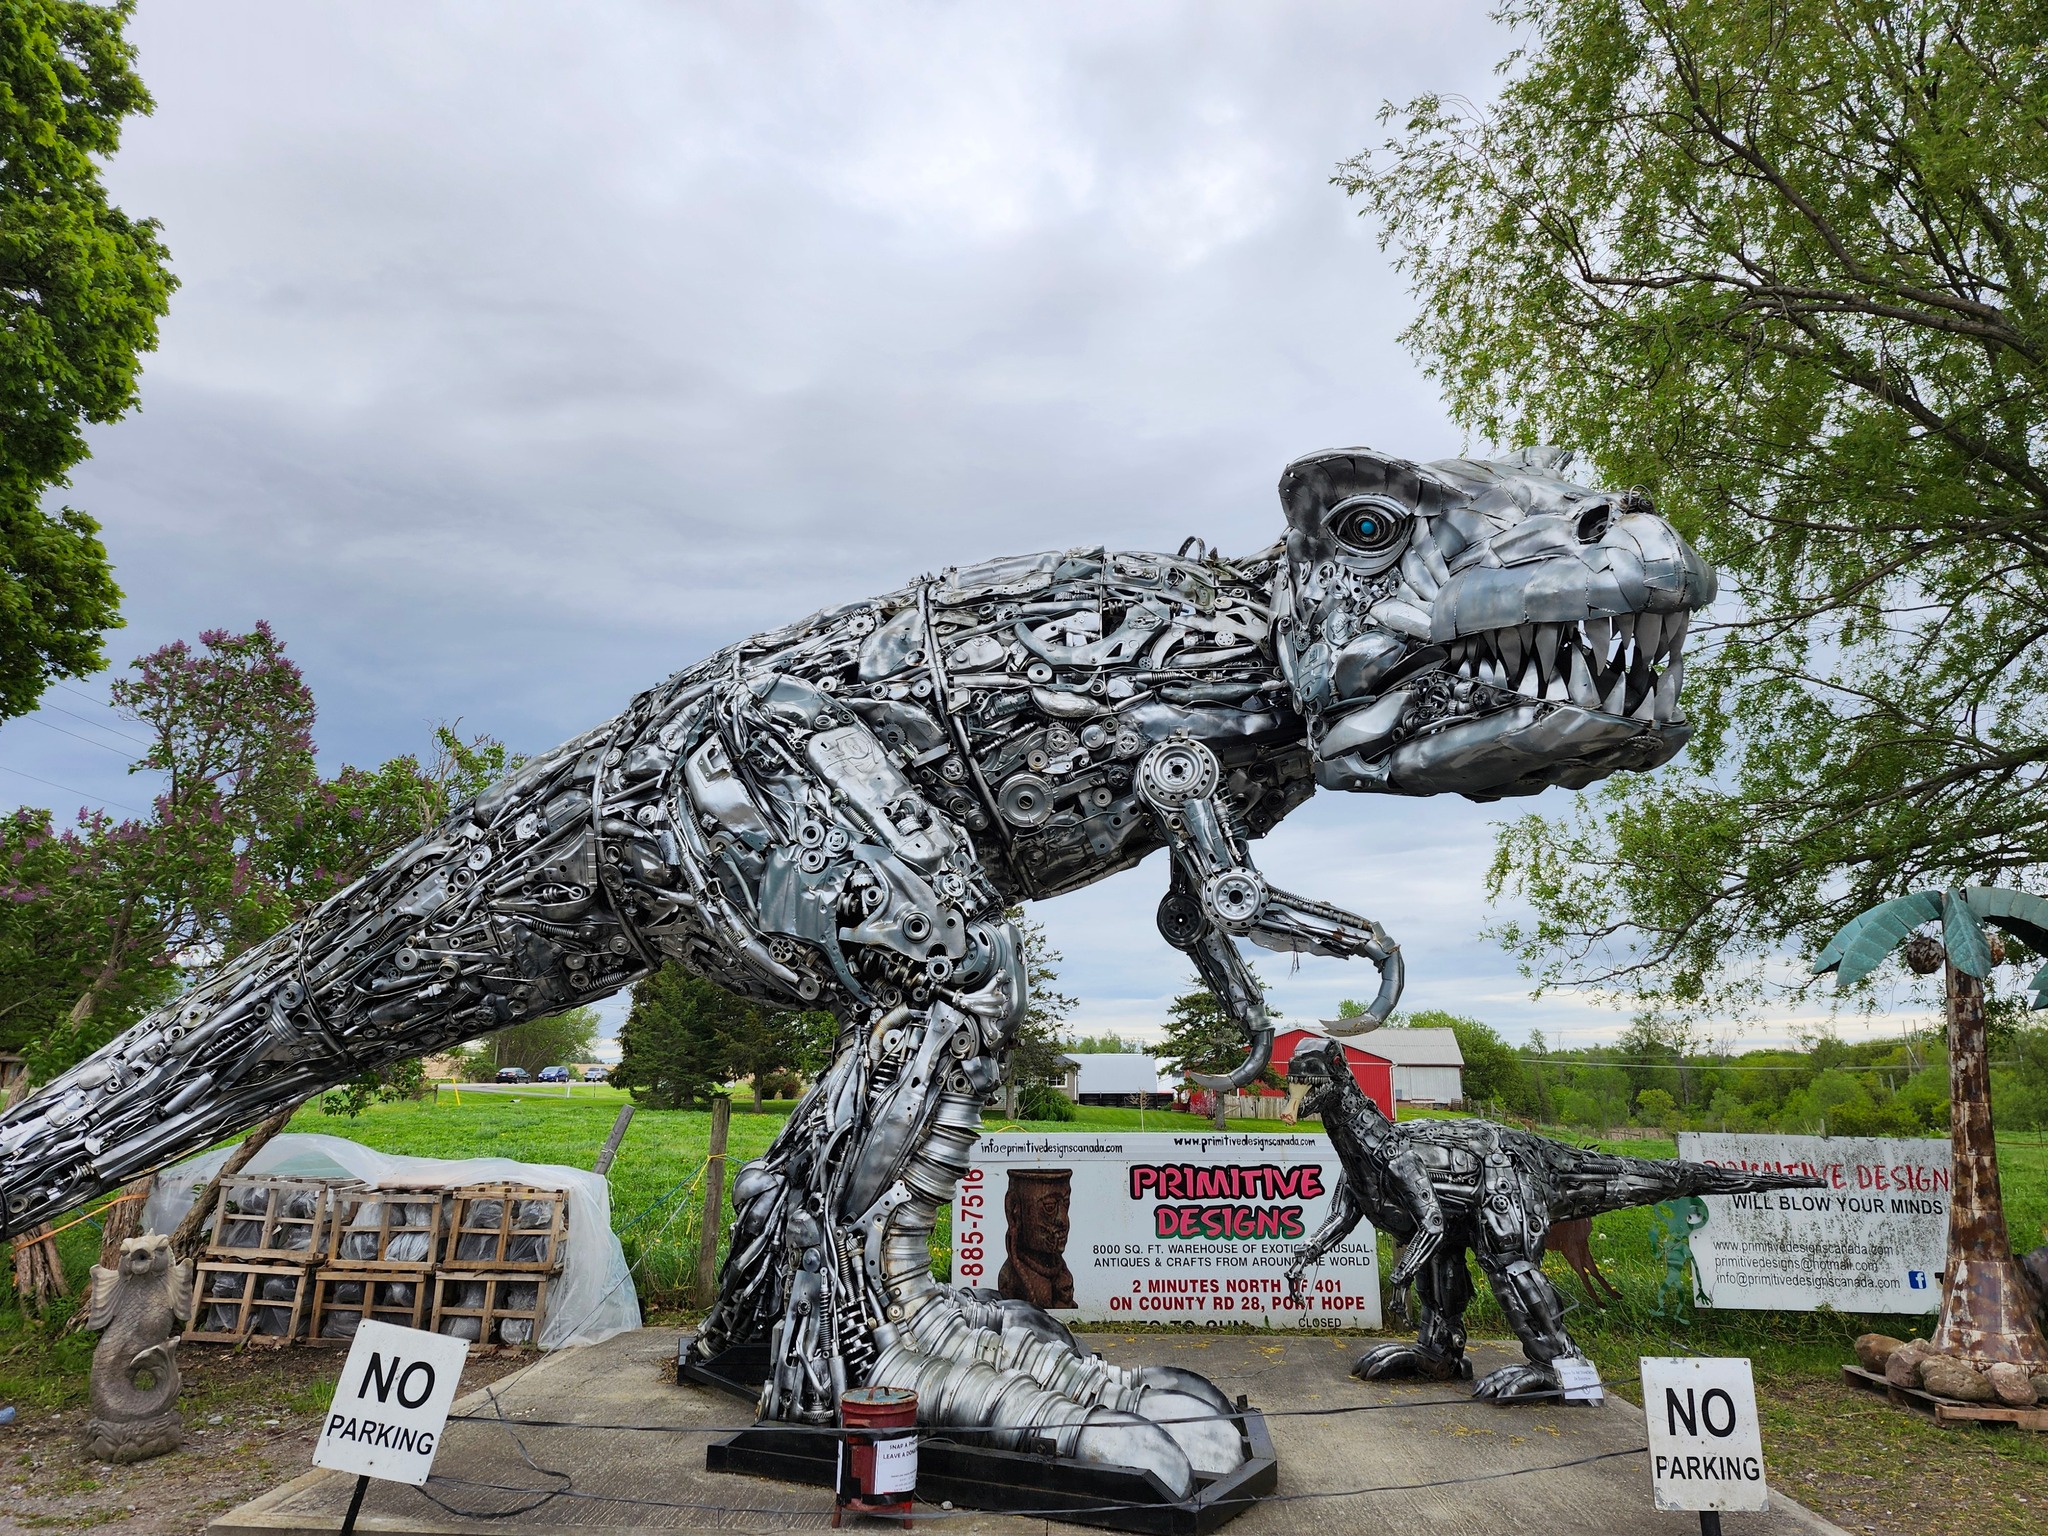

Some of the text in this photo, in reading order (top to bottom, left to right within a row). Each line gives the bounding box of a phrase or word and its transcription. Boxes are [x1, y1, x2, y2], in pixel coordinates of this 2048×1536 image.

[981, 1138, 1123, 1159] info@primitivedesignscanada.com
[1173, 1135, 1316, 1153] www.primitivedesignscanada.com
[1130, 1163, 1325, 1200] PRIMITIVE
[1733, 1195, 1943, 1215] WILL BLOW YOUR MINDS
[1155, 1205, 1304, 1239] DESIGNS
[1092, 1244, 1121, 1254] 8000
[1124, 1244, 1143, 1254] SQ.
[1147, 1244, 1164, 1254] FT.
[1168, 1244, 1238, 1254] WAREHOUSE
[1242, 1244, 1257, 1253] OF
[1094, 1257, 1150, 1267] ANTIQUES
[1154, 1257, 1162, 1267] &
[1166, 1257, 1212, 1267] CRAFTS
[1216, 1257, 1248, 1267] FROM
[1329, 1256, 1370, 1267] WORLD
[1715, 1256, 1878, 1273] primitivedesigns@hotmail.com
[1132, 1279, 1141, 1293] 2
[1148, 1279, 1219, 1293] MINUTES
[1226, 1279, 1282, 1293] NORTH
[1315, 1279, 1341, 1293] 401
[1717, 1272, 1900, 1289] info@primitivedesignscanada.com
[1109, 1296, 1132, 1310] ON
[1139, 1296, 1207, 1310] COUNTY
[1213, 1296, 1235, 1310] RD
[1241, 1296, 1265, 1312] 28,
[1322, 1296, 1366, 1310] HOPE
[1298, 1318, 1342, 1328] CLOSED
[357, 1352, 435, 1409] NO
[1665, 1388, 1736, 1437] NO
[326, 1414, 434, 1455] PARKING
[1656, 1455, 1760, 1481] PARKING
